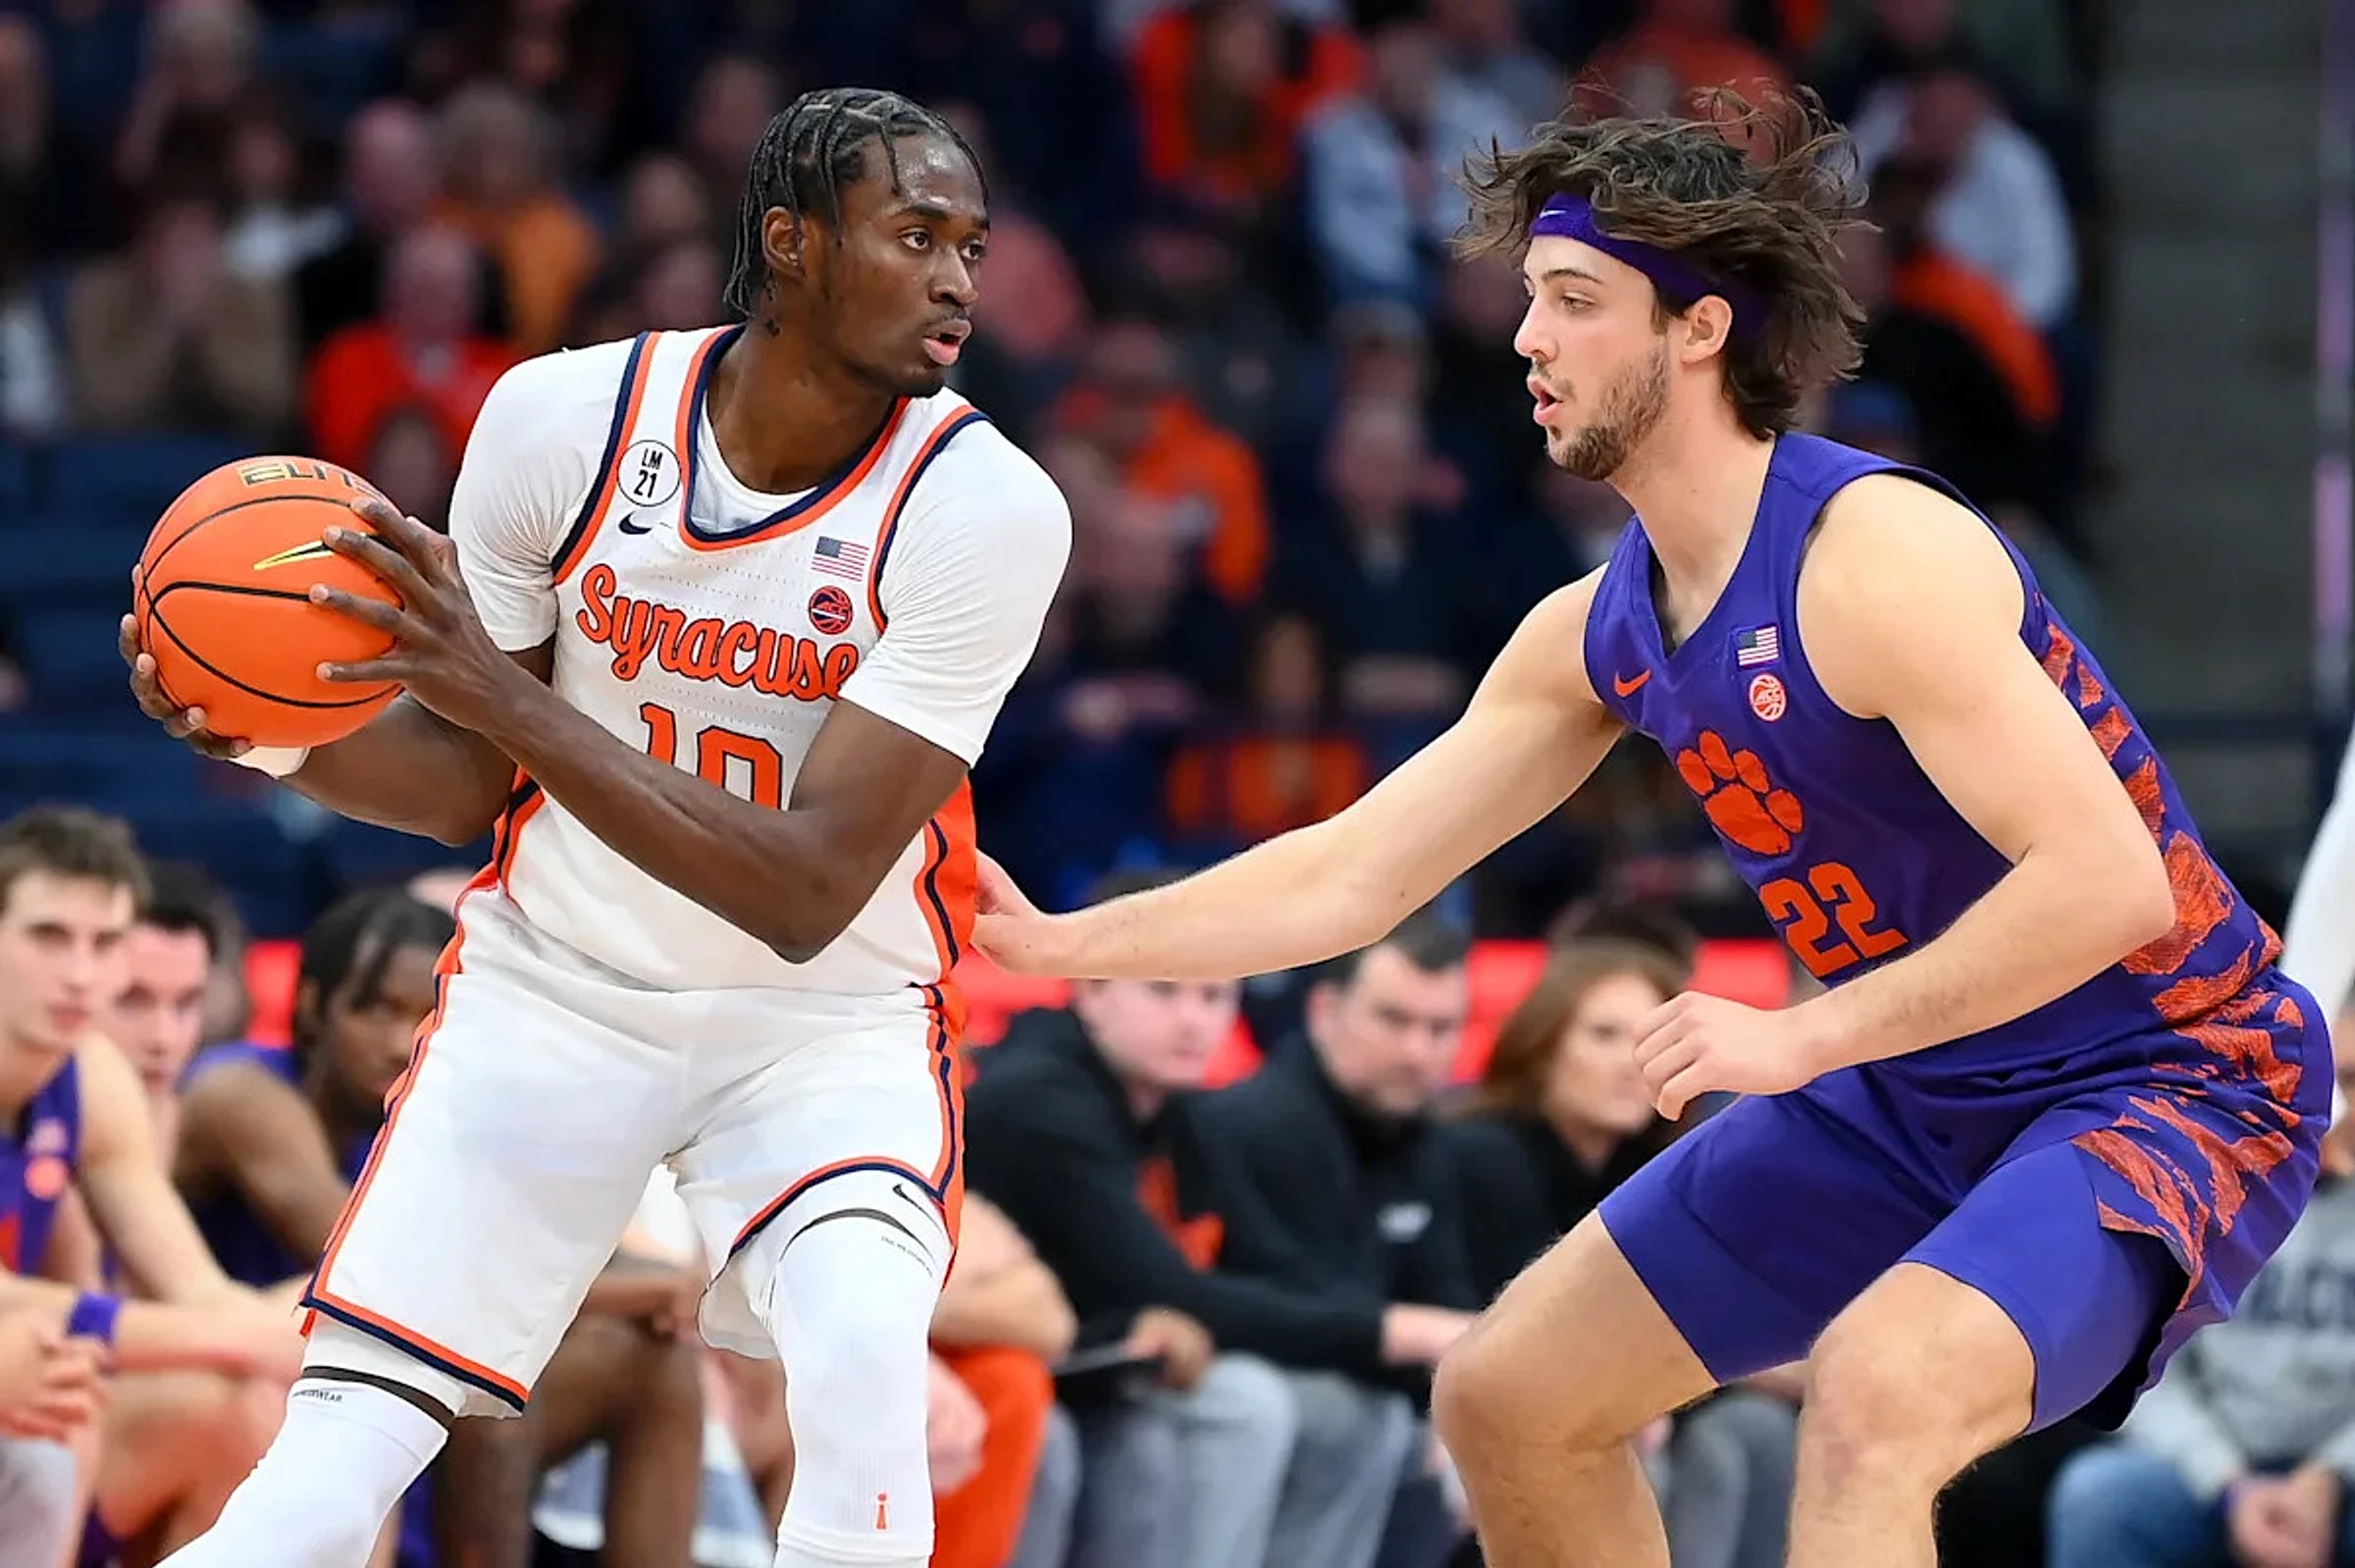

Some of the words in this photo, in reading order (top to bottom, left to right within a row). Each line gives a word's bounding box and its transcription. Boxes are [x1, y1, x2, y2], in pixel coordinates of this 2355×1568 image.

[634, 469, 657, 498] 21
[641, 447, 663, 470] LM
[575, 563, 859, 702] Syracuse
[1758, 862, 1909, 978] 22
